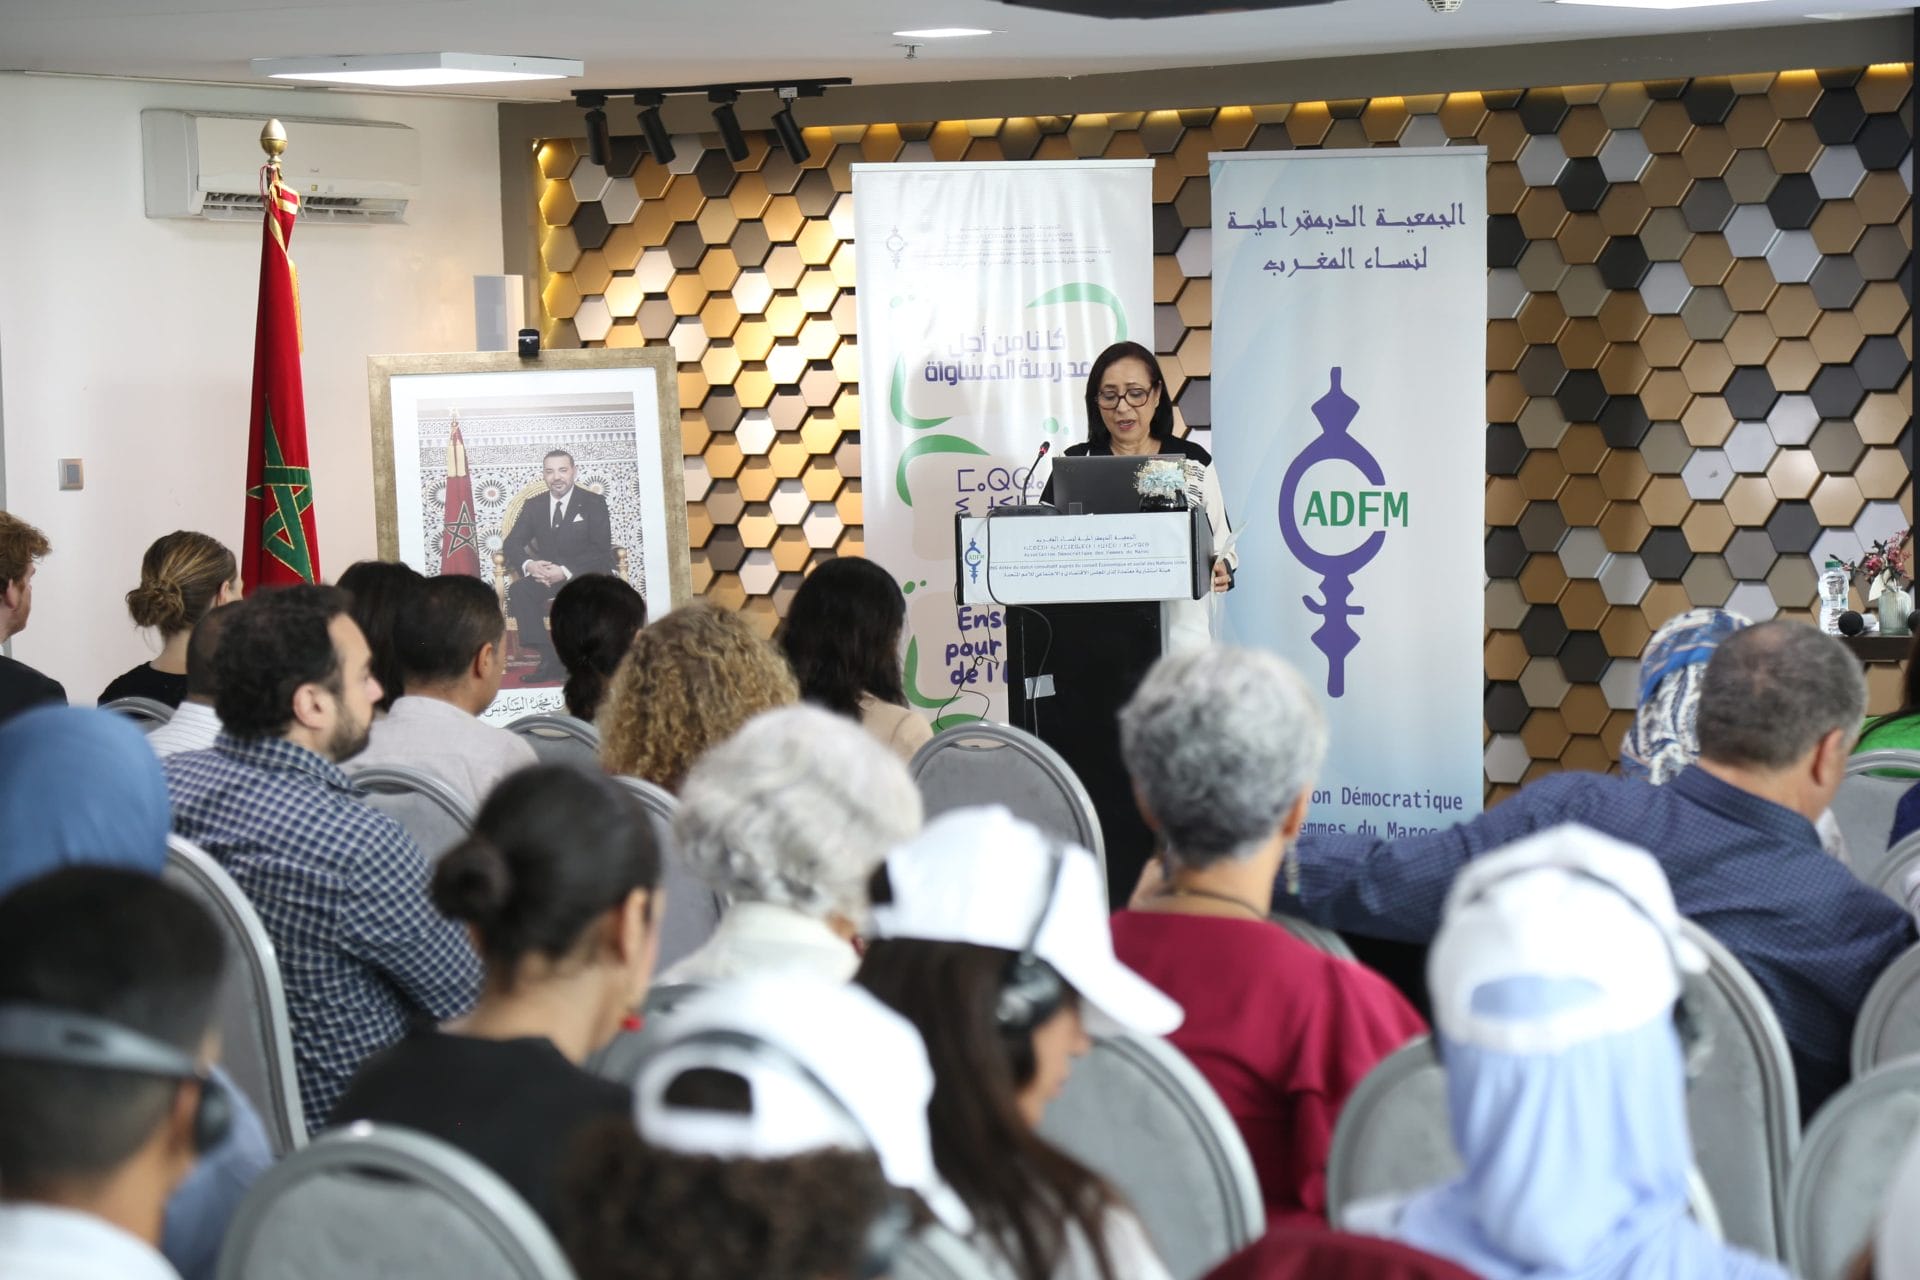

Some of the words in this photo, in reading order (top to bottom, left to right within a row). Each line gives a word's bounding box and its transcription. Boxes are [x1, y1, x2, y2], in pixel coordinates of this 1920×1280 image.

[1263, 246, 1355, 278] المغرب
[1364, 246, 1428, 272] لنساء
[1302, 490, 1409, 528] ADFM
[958, 606, 1006, 631] Ens
[945, 639, 1002, 666] pour
[950, 661, 978, 686] de
[1341, 786, 1463, 814] Démocratique
[1299, 822, 1347, 836] emmes
[1357, 819, 1377, 838] du
